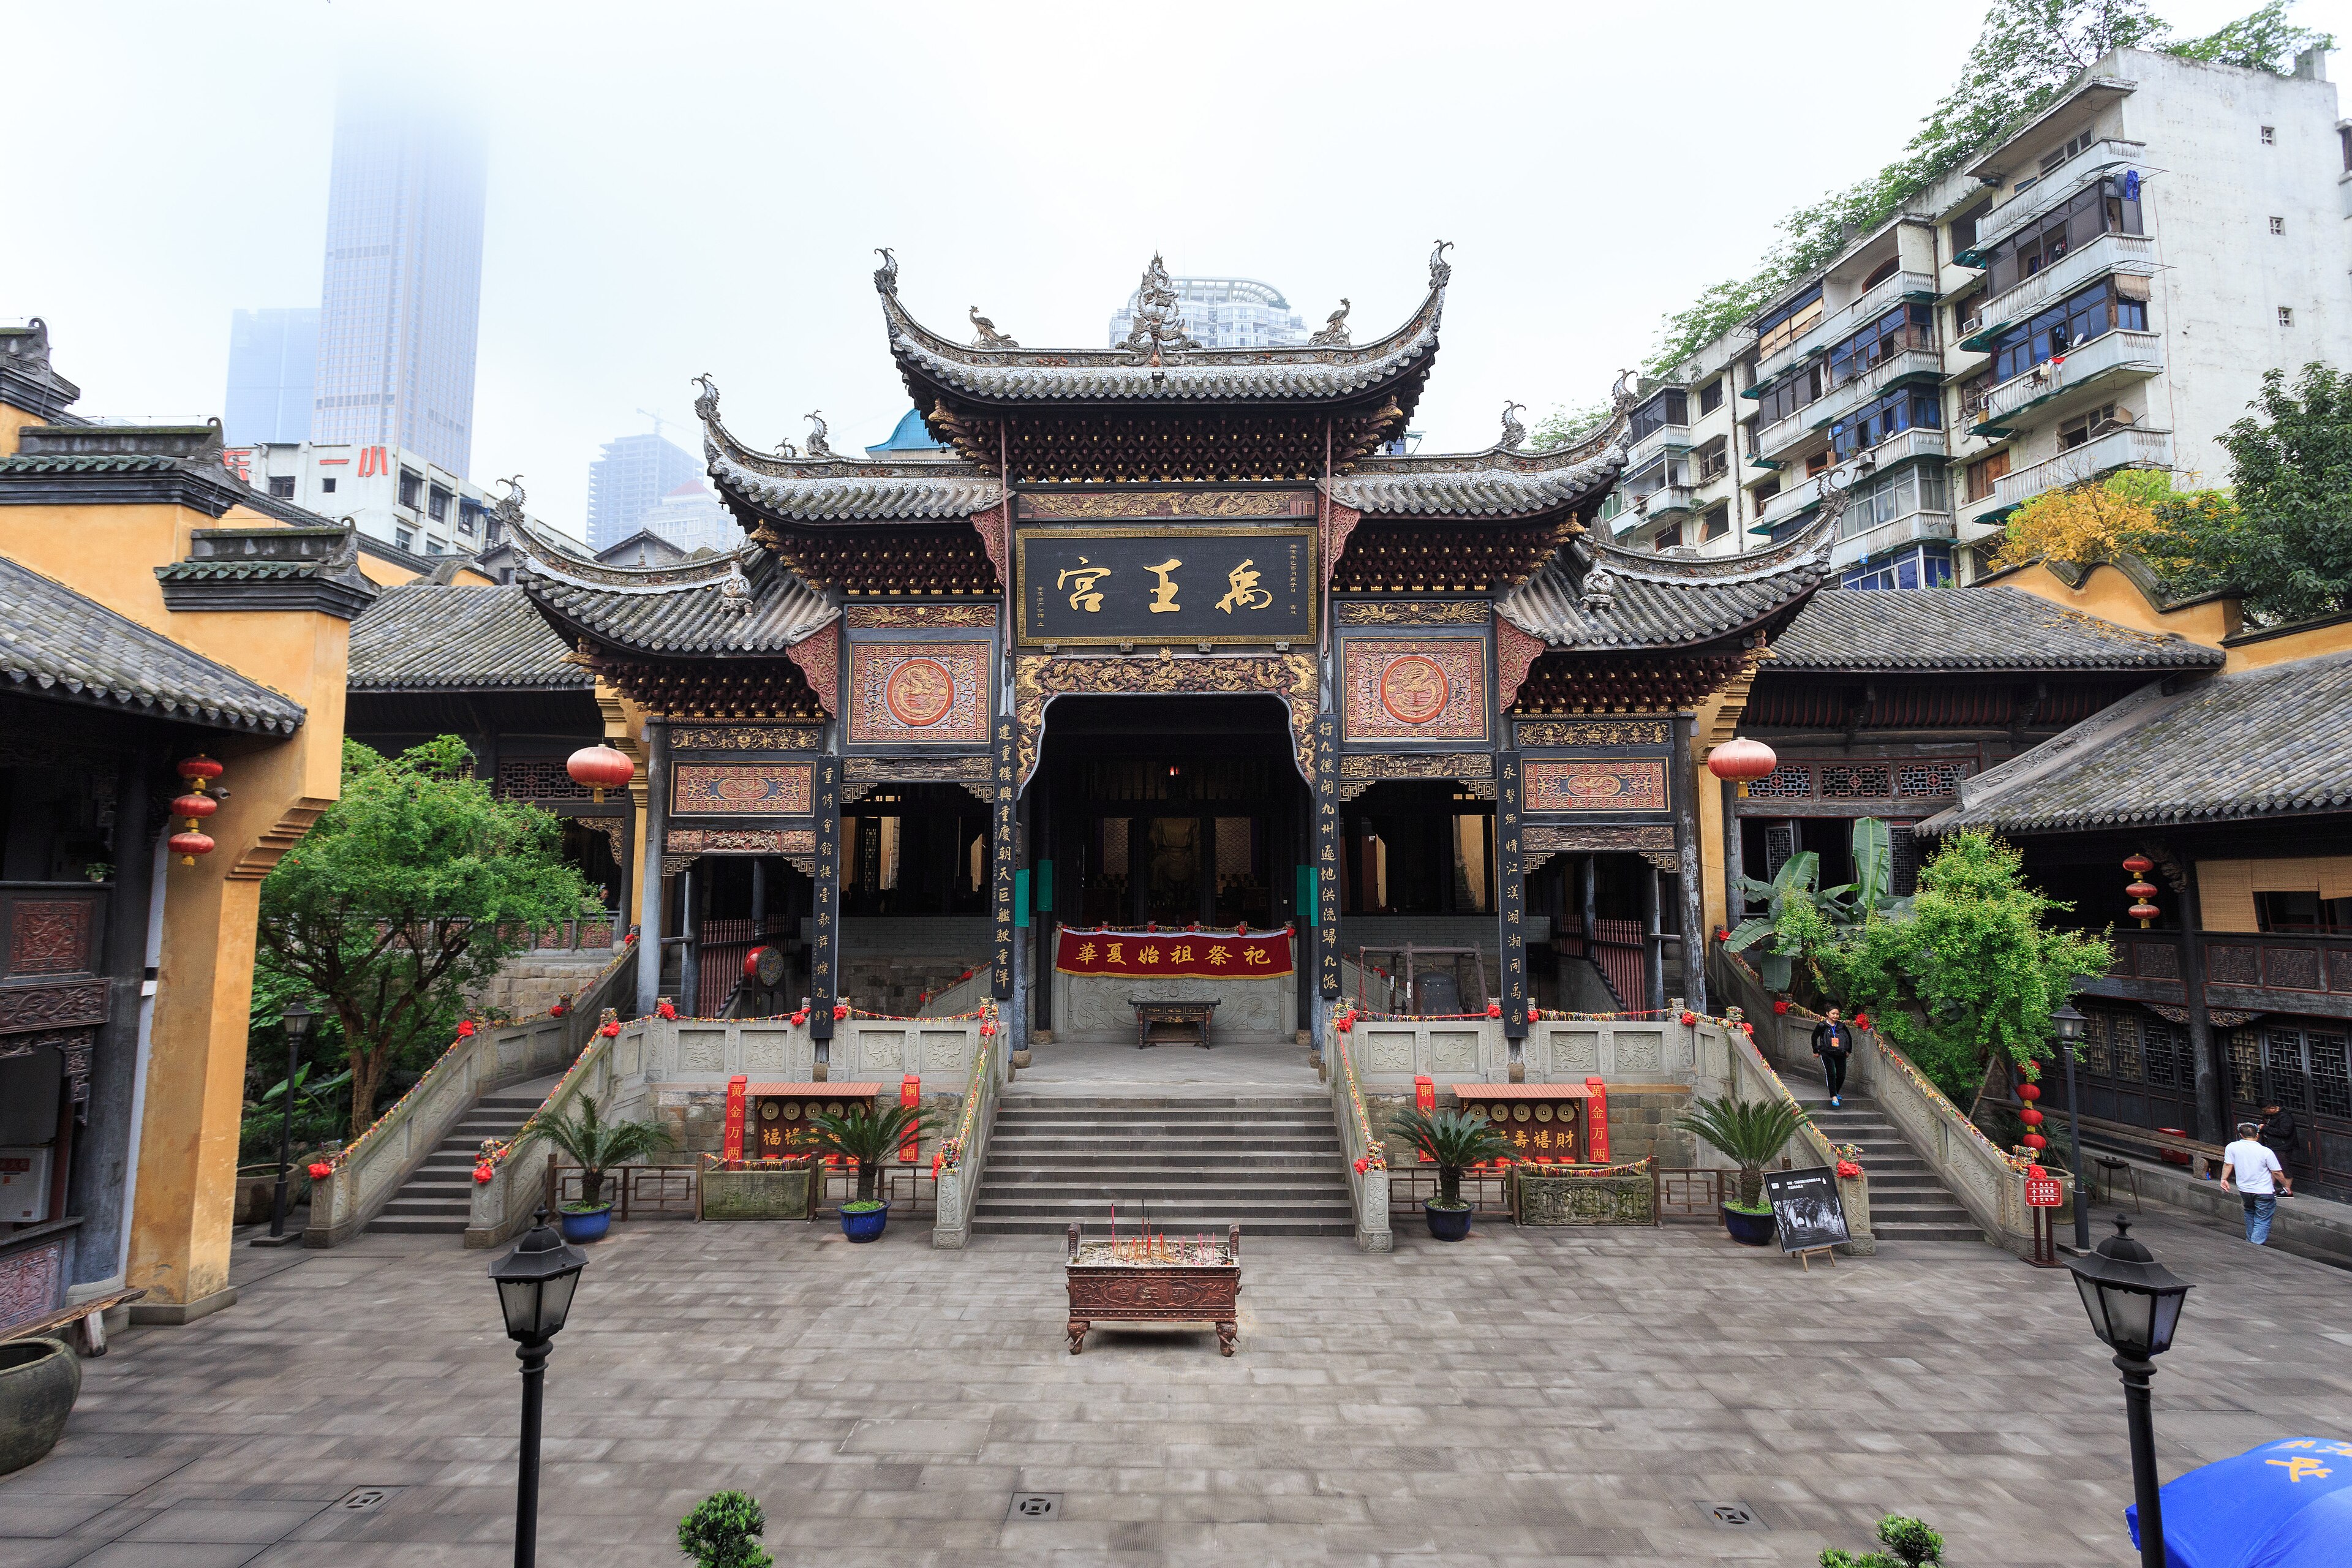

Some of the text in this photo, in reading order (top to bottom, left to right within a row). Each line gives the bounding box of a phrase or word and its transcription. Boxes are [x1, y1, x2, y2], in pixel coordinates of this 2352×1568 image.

[1075, 942, 1272, 966] 華夏始祖祭祀
[727, 1084, 743, 1159] 黄金万两
[1590, 1084, 1607, 1162] 黄金万两
